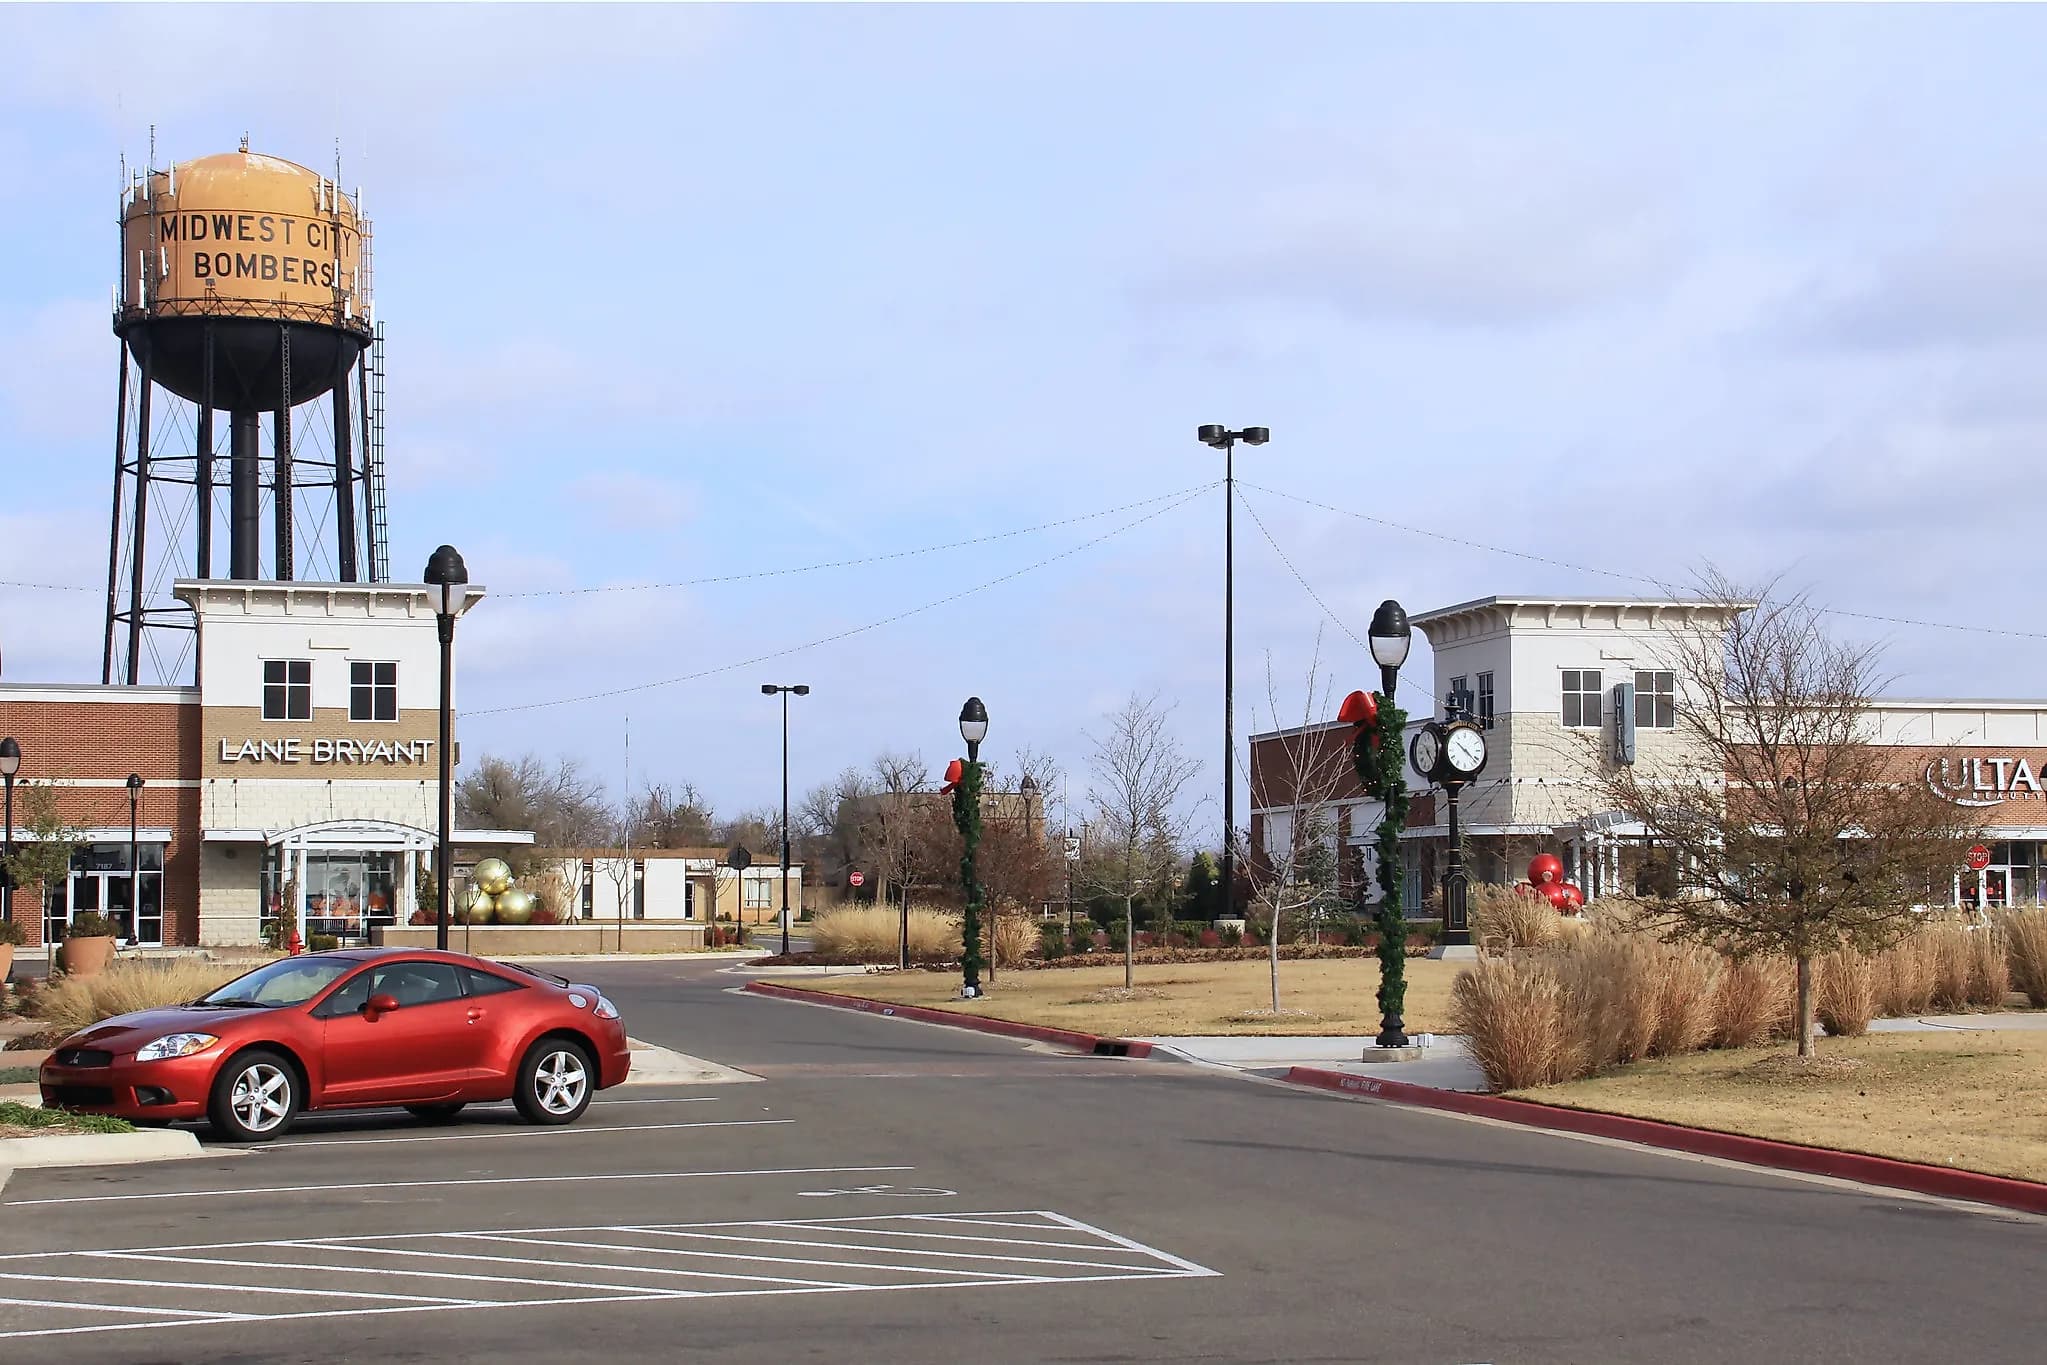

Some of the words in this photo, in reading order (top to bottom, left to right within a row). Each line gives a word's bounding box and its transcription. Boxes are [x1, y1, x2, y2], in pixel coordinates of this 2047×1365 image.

[160, 214, 296, 244] MIDWEST
[307, 223, 352, 257] CITY
[194, 252, 333, 287] BOMBERS
[1615, 690, 1624, 758] ULTA
[221, 737, 302, 762] LANE
[313, 738, 435, 763] BRYANT
[1940, 757, 2043, 791] ULTA
[1972, 791, 2043, 800] BEAUTY
[1967, 852, 1988, 862] STOP
